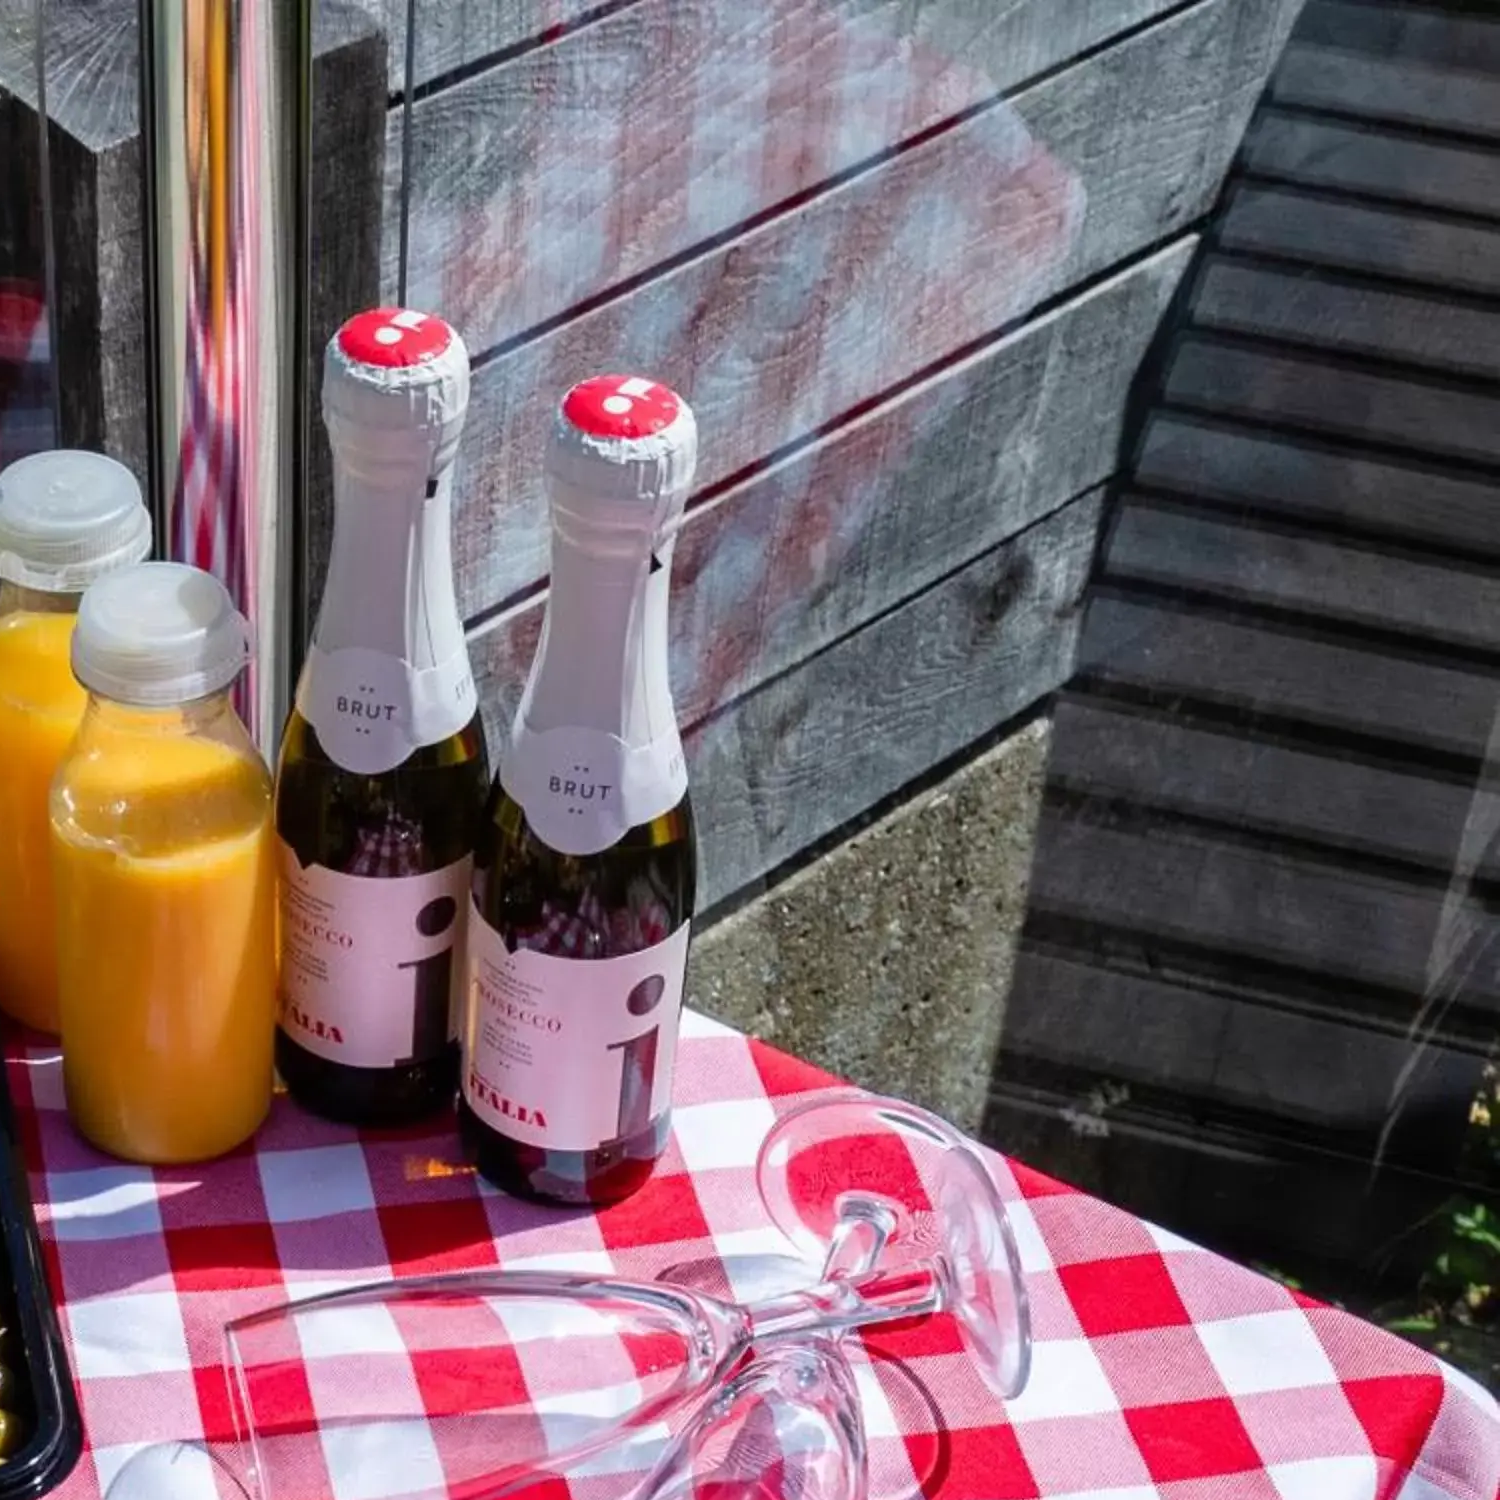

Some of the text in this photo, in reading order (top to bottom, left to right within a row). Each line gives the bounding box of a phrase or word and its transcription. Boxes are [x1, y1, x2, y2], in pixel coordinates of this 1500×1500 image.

[336, 695, 397, 721] BRUT
[548, 774, 613, 801] BRUT
[470, 1073, 547, 1127] ITALIA
